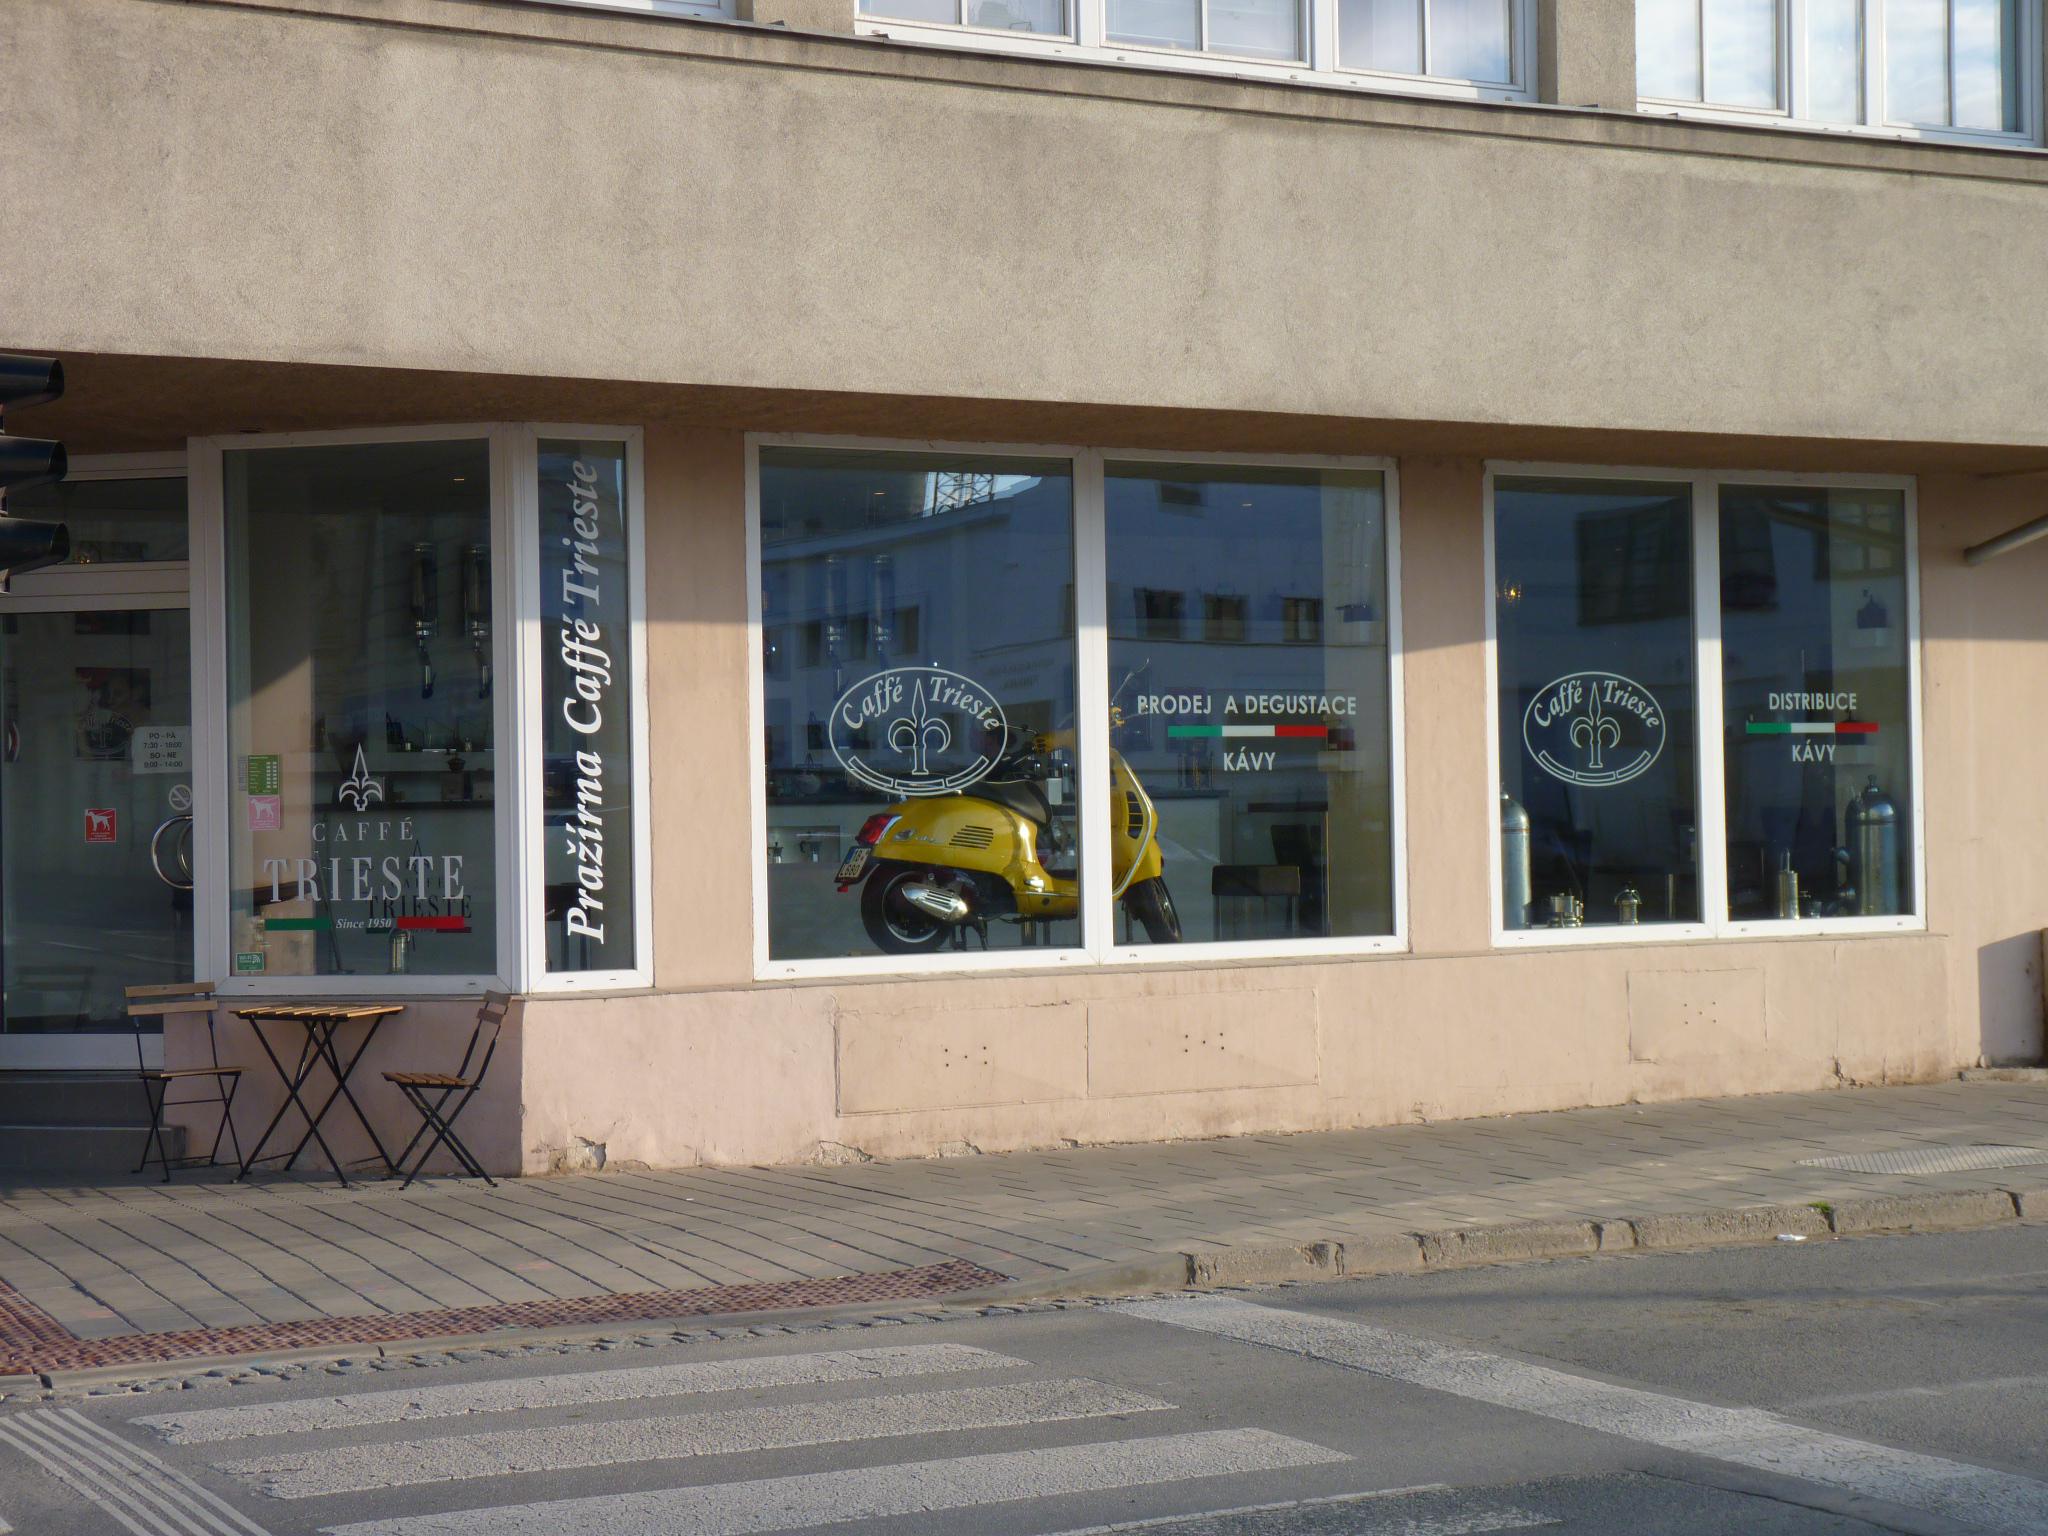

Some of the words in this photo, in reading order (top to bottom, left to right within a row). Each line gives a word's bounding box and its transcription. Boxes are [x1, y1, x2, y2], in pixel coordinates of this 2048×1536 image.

[562, 460, 600, 607] Trieste
[561, 613, 612, 735] Caffé
[842, 676, 903, 730] Caffé
[929, 676, 1001, 730] Trieste
[1137, 694, 1213, 715] PRODEJ
[1223, 695, 1239, 715] A
[1245, 694, 1357, 716] DEGUSTACE
[1534, 680, 1583, 727] Caffé
[1603, 680, 1660, 728] Trieste
[1768, 692, 1857, 711] DISTRIBUCE
[1223, 746, 1276, 772] KÁVY
[1791, 739, 1836, 762] KÁVY
[312, 817, 415, 842] CAFFÉ
[566, 750, 604, 944] Pražírna
[264, 855, 465, 902] TRIESTE
[336, 917, 365, 930] Since
[368, 917, 393, 929] 1950
